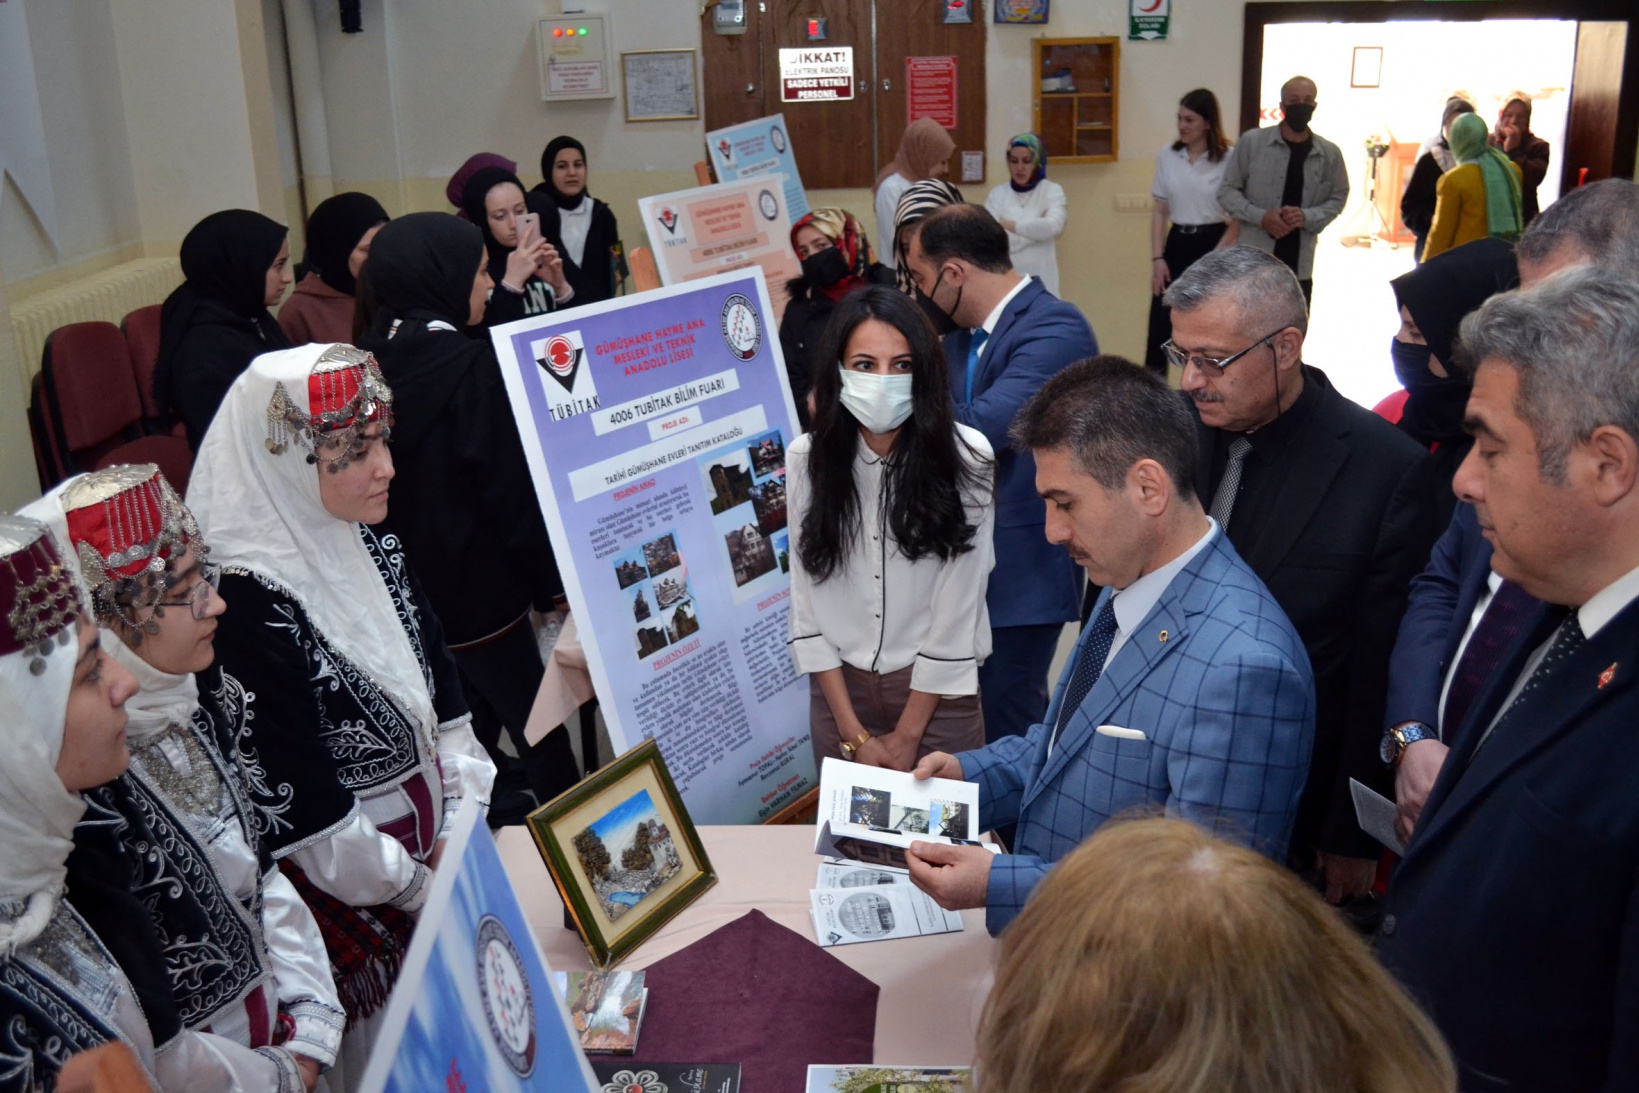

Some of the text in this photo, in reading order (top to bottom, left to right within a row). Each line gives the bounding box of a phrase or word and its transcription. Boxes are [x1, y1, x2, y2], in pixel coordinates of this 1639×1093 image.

[787, 79, 818, 88] SADECE
[798, 89, 838, 99] PERSONEL
[596, 319, 704, 355] GÜMÜŞHANE HAYME ANA
[614, 334, 695, 364] MESLEKİ VE TEKNİK
[625, 348, 693, 375] ANADOLU LİSESİ
[549, 395, 601, 421] TÜBİTAK
[610, 379, 725, 424] 4006 TUBİTAK BİLİM FUARI
[661, 420, 678, 430] PROJE
[605, 427, 742, 484] TARİHİ GÜMÜŞHANE EVLERİ TANITIM KATALOĞU
